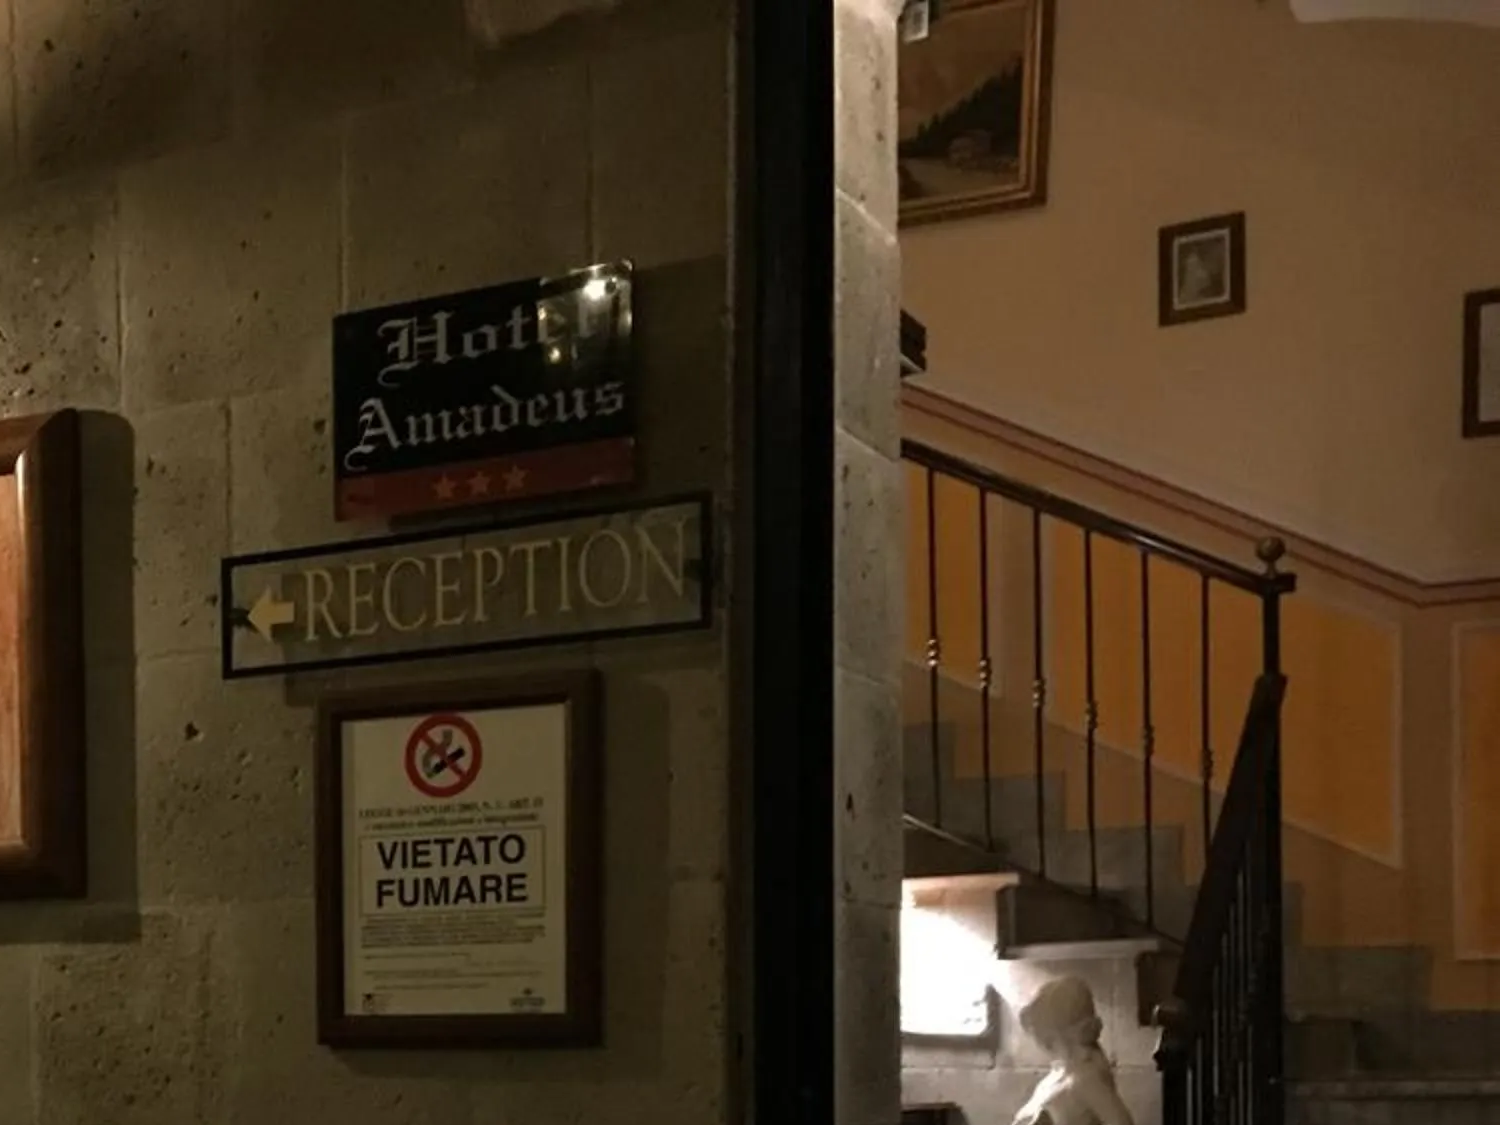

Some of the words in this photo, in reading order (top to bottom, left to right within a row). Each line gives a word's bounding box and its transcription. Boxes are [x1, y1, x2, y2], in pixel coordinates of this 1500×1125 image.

[343, 378, 626, 473] Amadeus
[303, 515, 691, 644] RECEPTION
[376, 833, 526, 870] VIETATO
[376, 872, 529, 909] FUMARE
